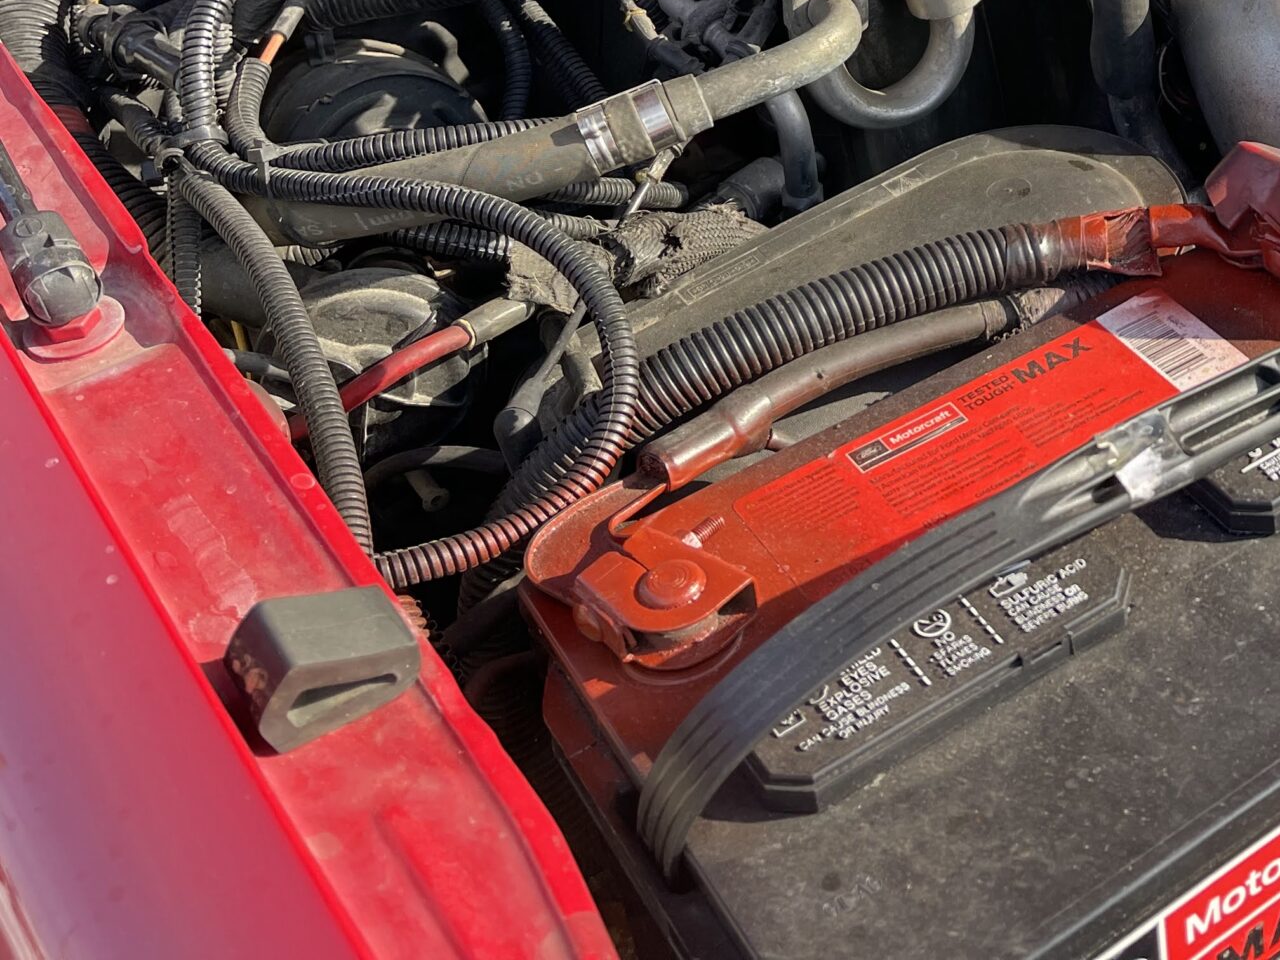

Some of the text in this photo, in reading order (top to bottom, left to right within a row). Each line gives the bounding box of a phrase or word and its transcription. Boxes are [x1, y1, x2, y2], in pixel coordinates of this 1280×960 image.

[957, 336, 1094, 404] TESTED MAX
[889, 409, 952, 446] Motorcraft
[1000, 558, 1087, 610] SULFURIC ACID
[1008, 584, 1063, 617] CAN CAUSE
[933, 634, 973, 660] SPARKS
[934, 630, 956, 647] NO
[818, 665, 891, 712] EXPLOSIVE
[841, 661, 878, 687] EYES
[799, 682, 911, 751] CAN CAUSE BLINDNESS
[826, 690, 872, 721] GASES
